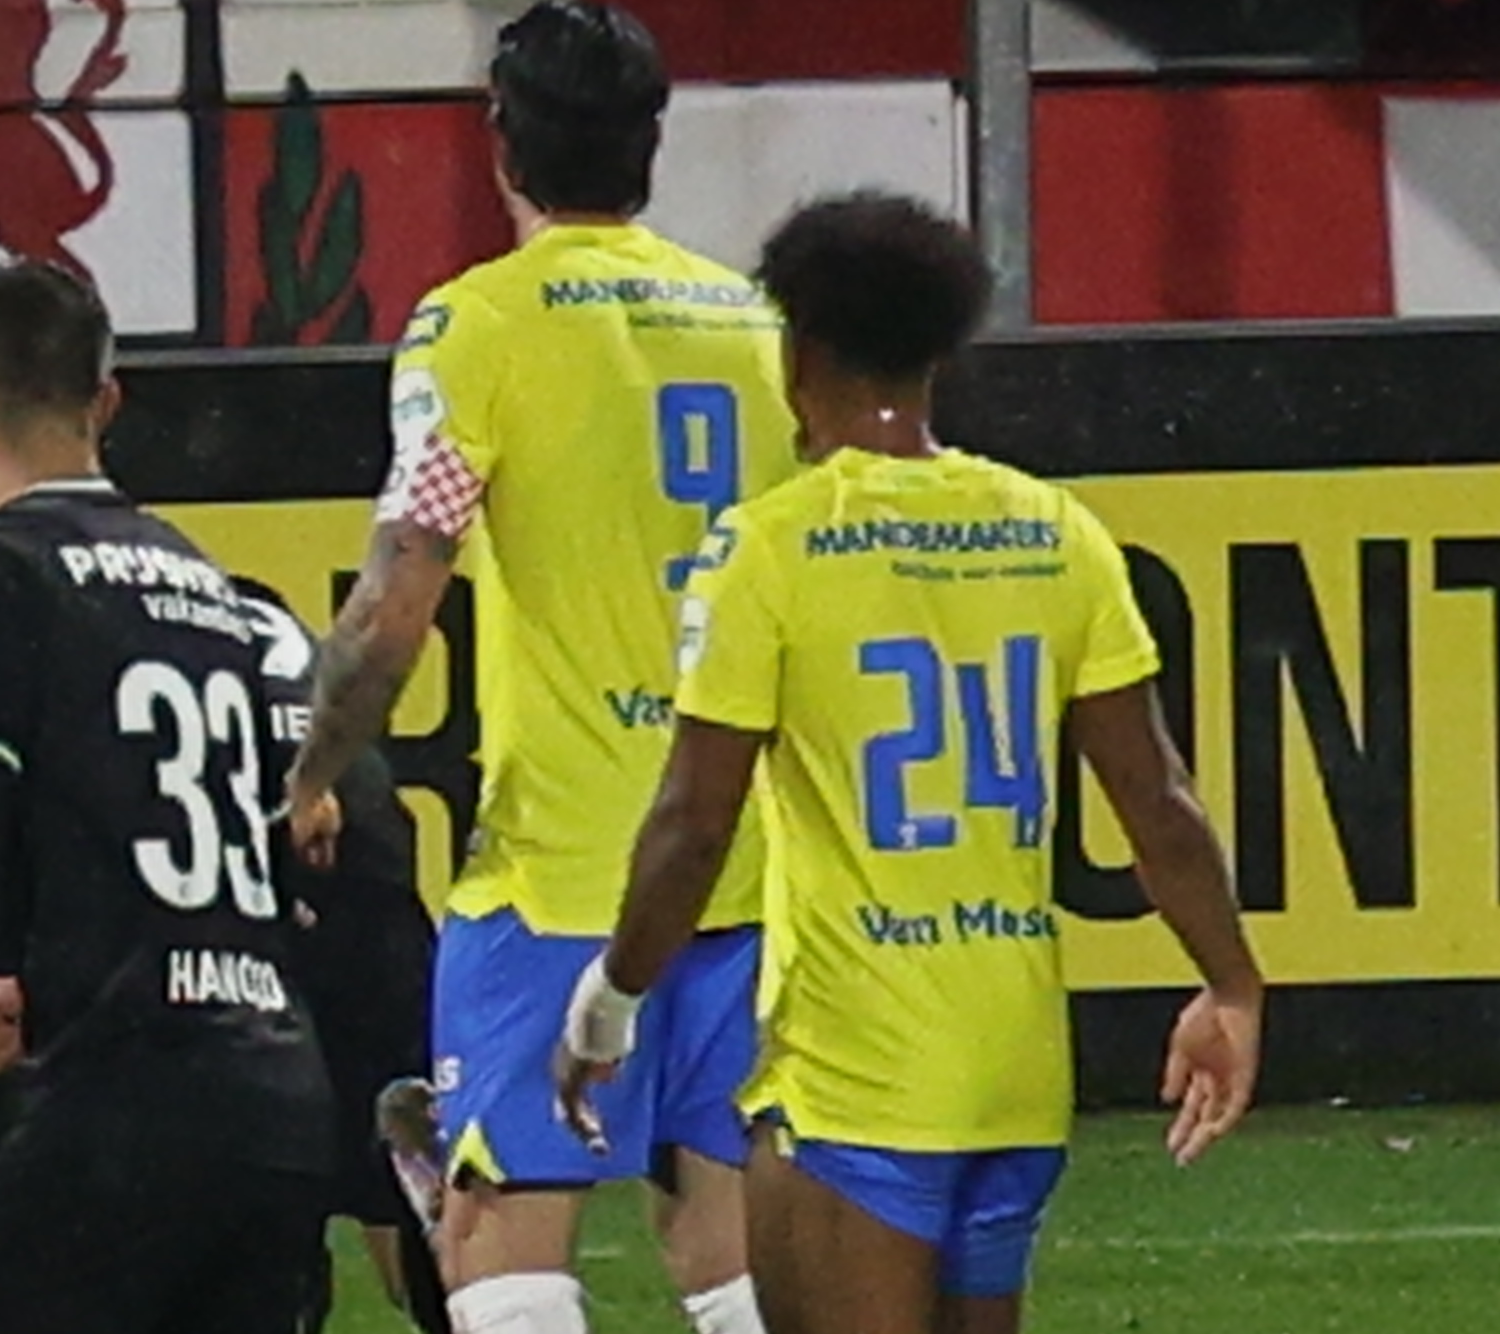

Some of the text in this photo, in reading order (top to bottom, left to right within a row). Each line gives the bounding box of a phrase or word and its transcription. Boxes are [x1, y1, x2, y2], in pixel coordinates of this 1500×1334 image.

[657, 382, 740, 592] 9
[115, 660, 279, 918] 33
[858, 635, 1048, 851] 24
